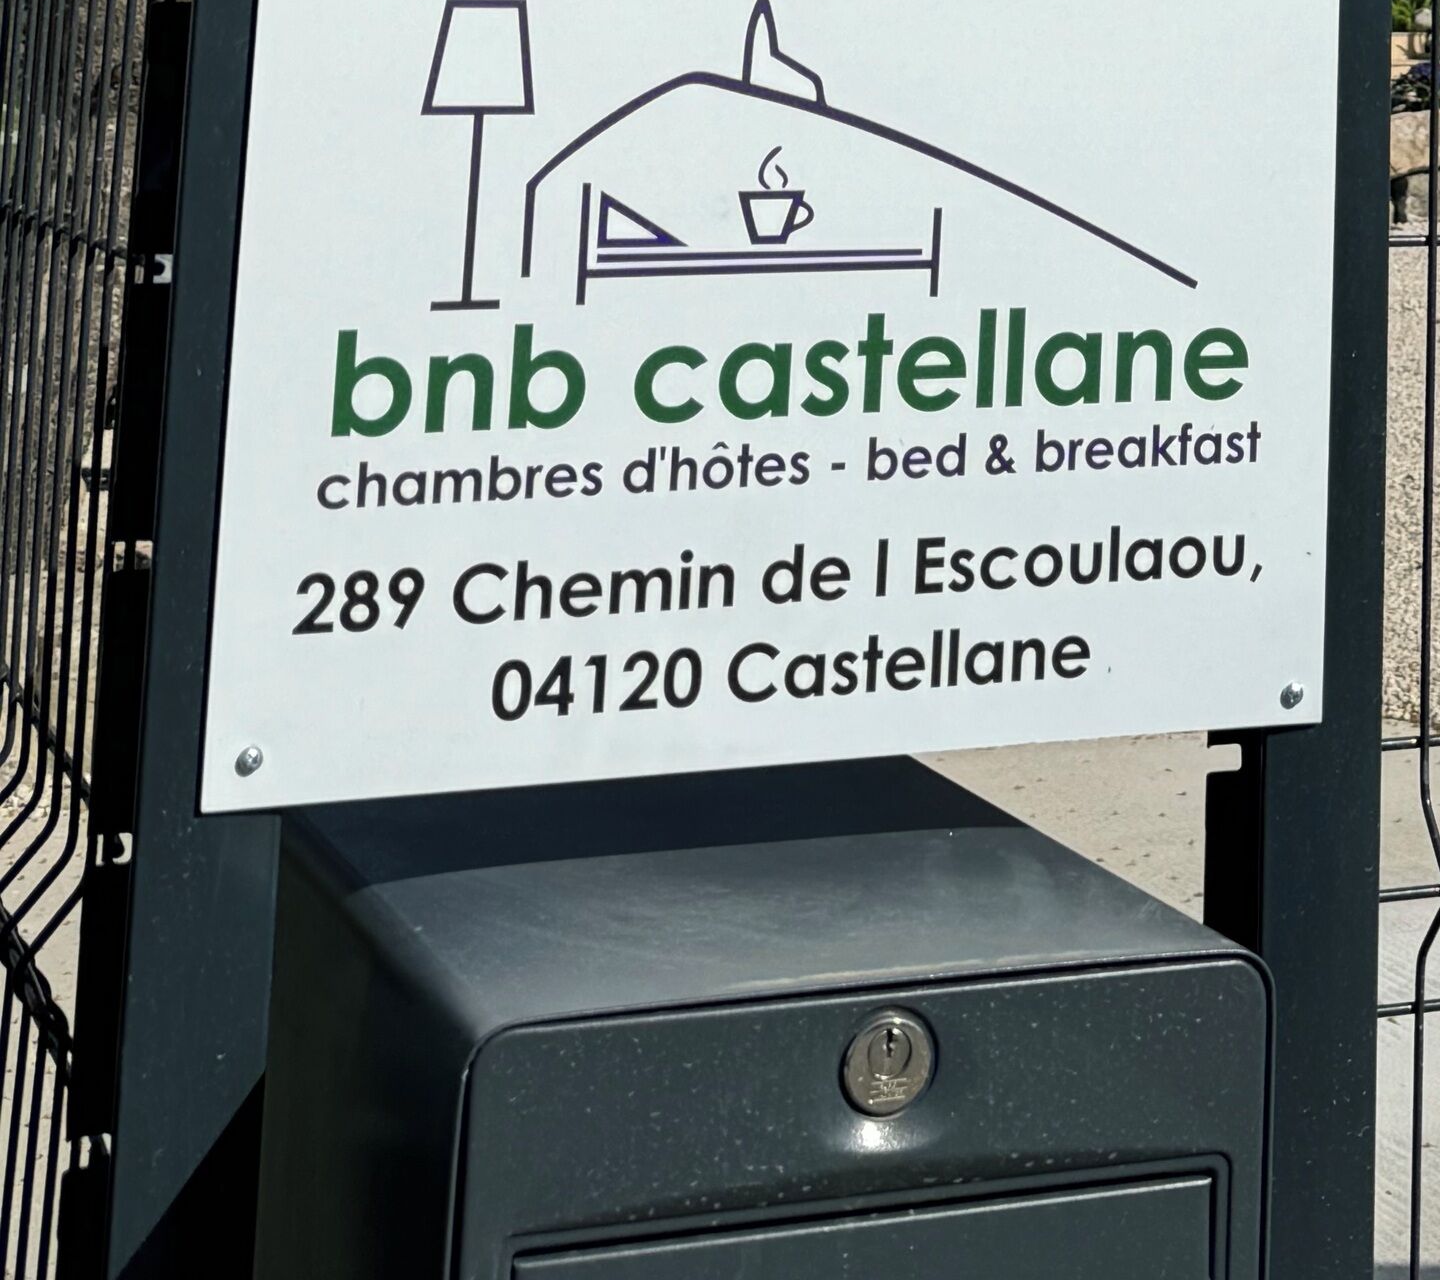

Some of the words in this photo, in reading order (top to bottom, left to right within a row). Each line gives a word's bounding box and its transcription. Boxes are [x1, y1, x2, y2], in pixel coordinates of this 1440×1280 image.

[330, 323, 586, 438] bnb
[633, 306, 1249, 424] castellane
[316, 461, 604, 510] chambres
[622, 441, 812, 494] d'hôtes
[830, 462, 846, 471] -
[867, 432, 967, 481] bed
[984, 433, 1017, 476] &
[1035, 420, 1262, 473] breakfast
[291, 566, 425, 636] 289
[452, 549, 735, 625] Chemin
[761, 543, 851, 605] de
[914, 525, 1263, 595] Escoulaou,
[491, 647, 703, 722] 04120
[727, 627, 1091, 704] Castellane
